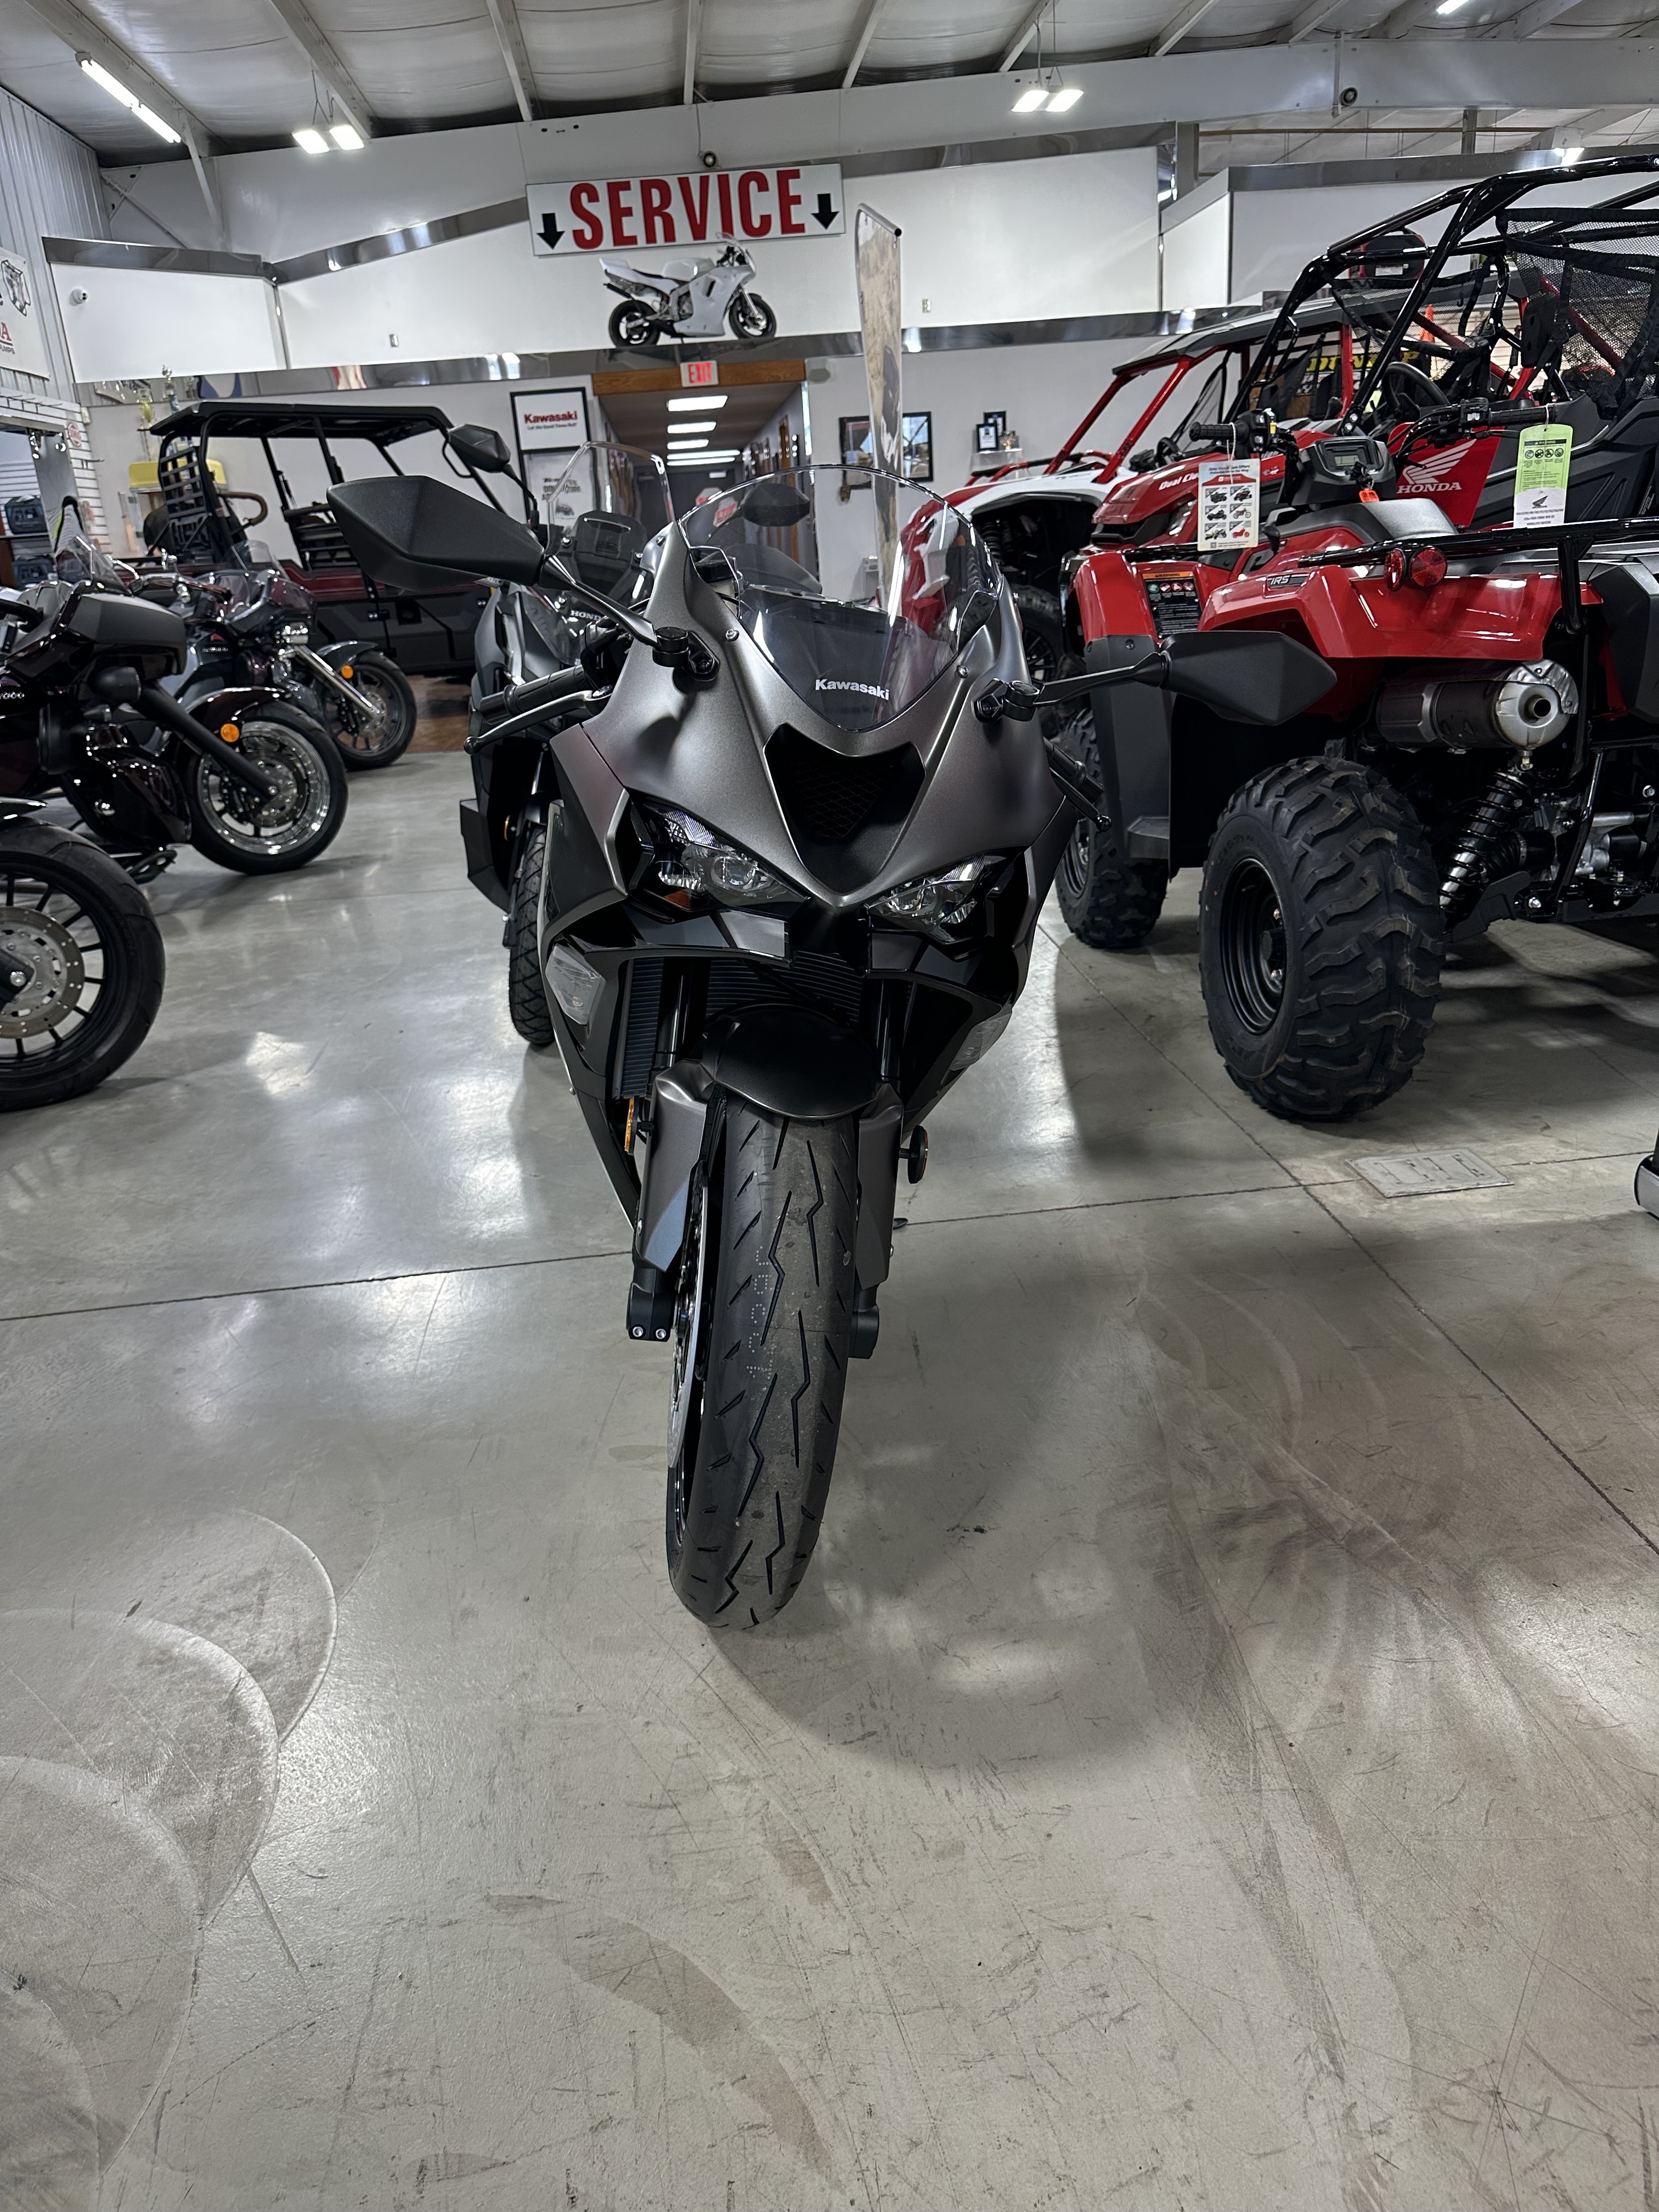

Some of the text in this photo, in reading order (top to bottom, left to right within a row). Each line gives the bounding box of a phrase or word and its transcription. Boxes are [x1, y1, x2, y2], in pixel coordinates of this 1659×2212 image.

[570, 169, 806, 250] SERVICE
[687, 362, 712, 383] EXIT
[523, 410, 578, 424] Kawasaki
[1158, 476, 1183, 490] Dual
[1396, 482, 1462, 494] HONDA
[571, 610, 602, 621] HOND
[815, 679, 889, 701] Kawasaki
